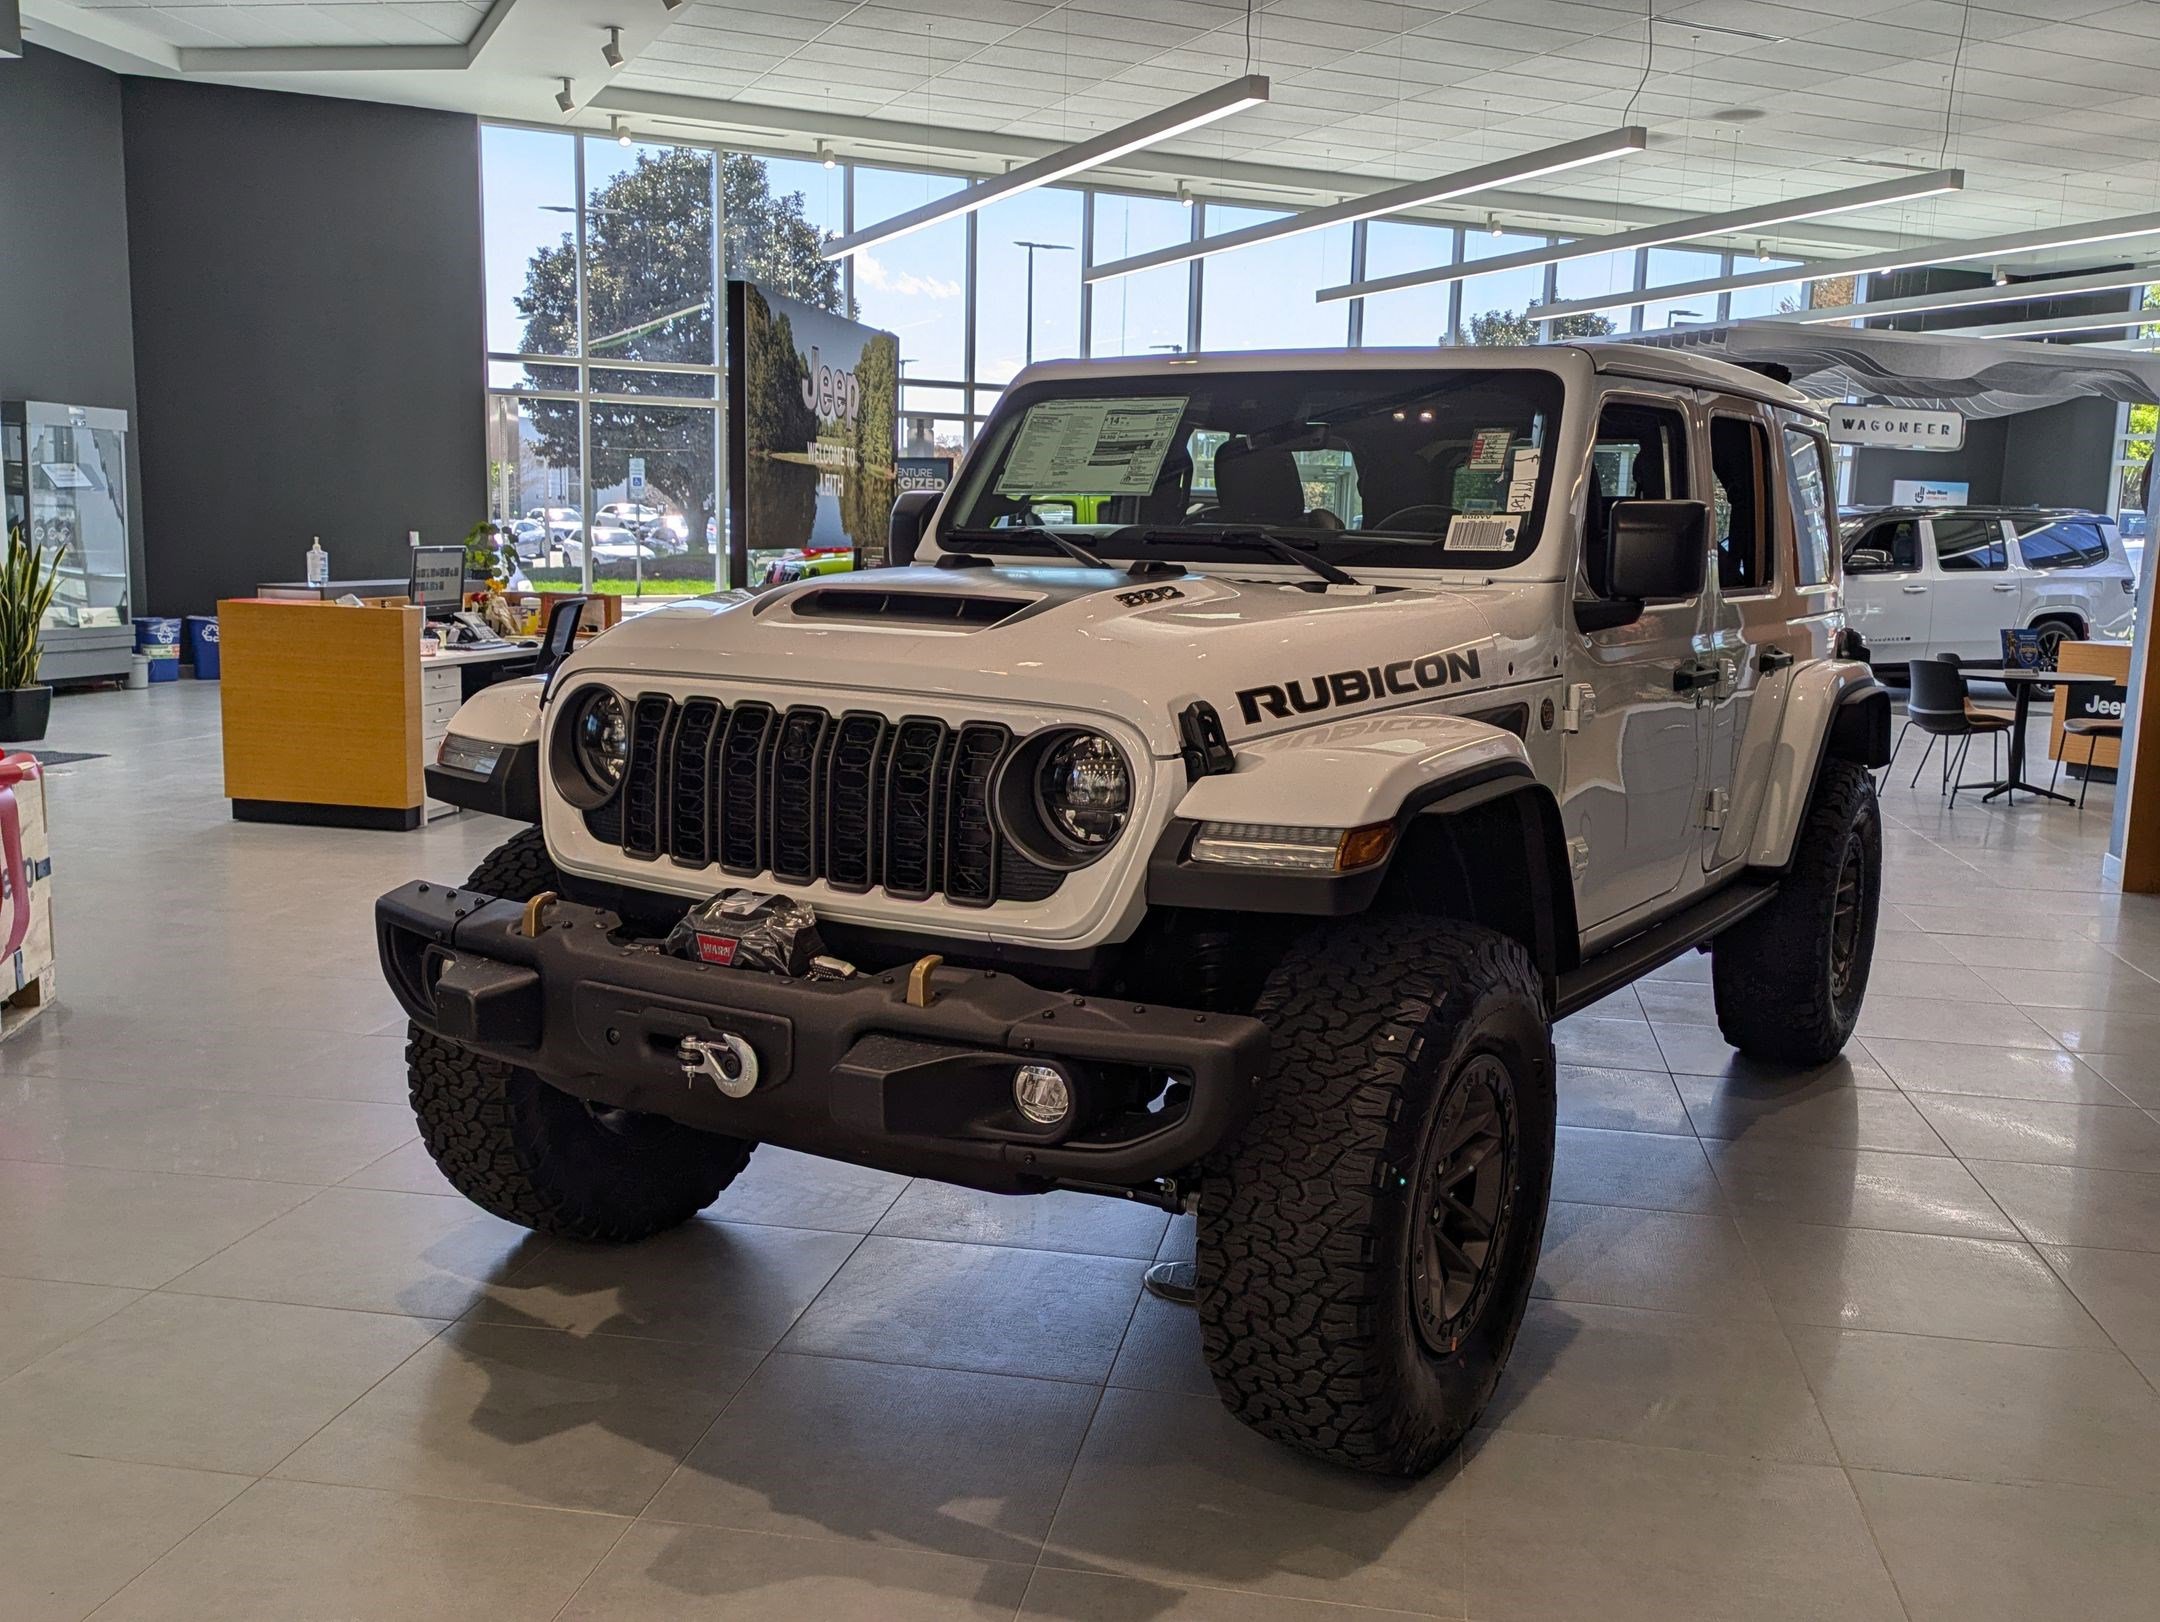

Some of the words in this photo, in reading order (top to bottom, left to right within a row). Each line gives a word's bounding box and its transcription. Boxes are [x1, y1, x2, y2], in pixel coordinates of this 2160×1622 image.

[802, 346, 860, 432] Jeep
[1841, 418, 1950, 436] WAGONEER
[807, 441, 845, 466] WELCOME
[845, 447, 856, 467] TO
[819, 473, 844, 497] LEITH
[1235, 648, 1482, 726] RUBICON
[704, 943, 731, 957] WARN
